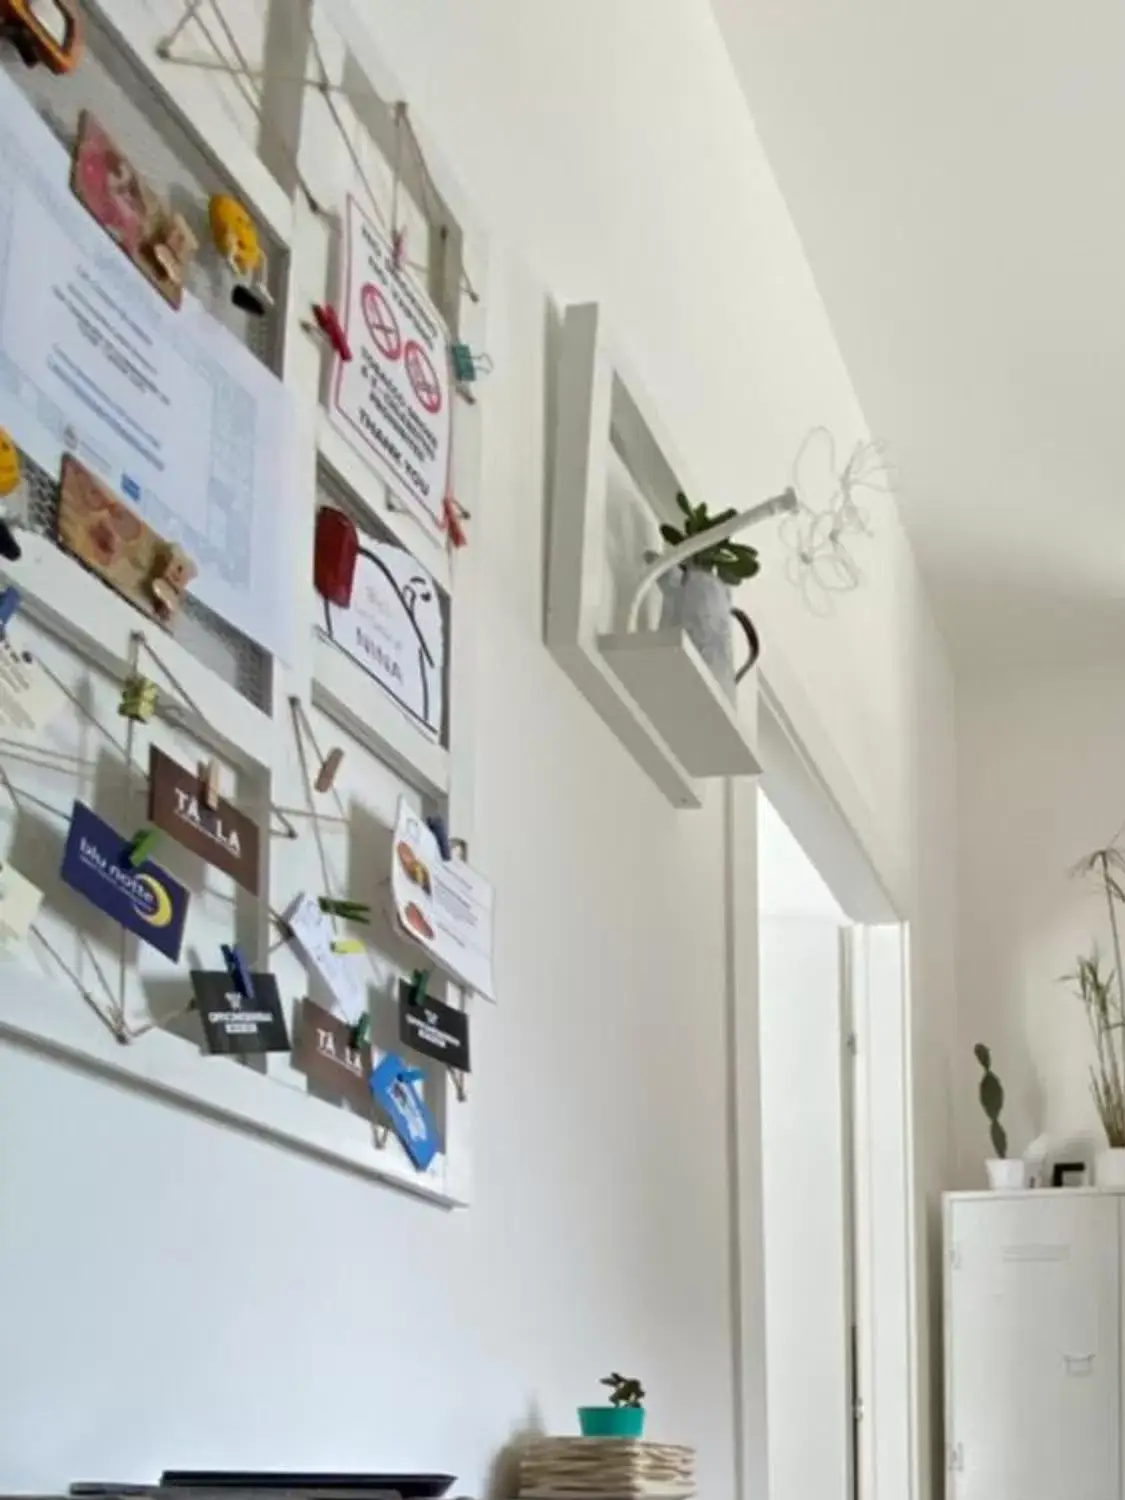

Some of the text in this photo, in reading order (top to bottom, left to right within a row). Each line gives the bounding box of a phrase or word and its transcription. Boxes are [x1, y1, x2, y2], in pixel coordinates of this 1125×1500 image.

[358, 406, 403, 465] THANK
[404, 460, 431, 497] YOU
[79, 836, 107, 869] blu
[109, 864, 155, 903] notte
